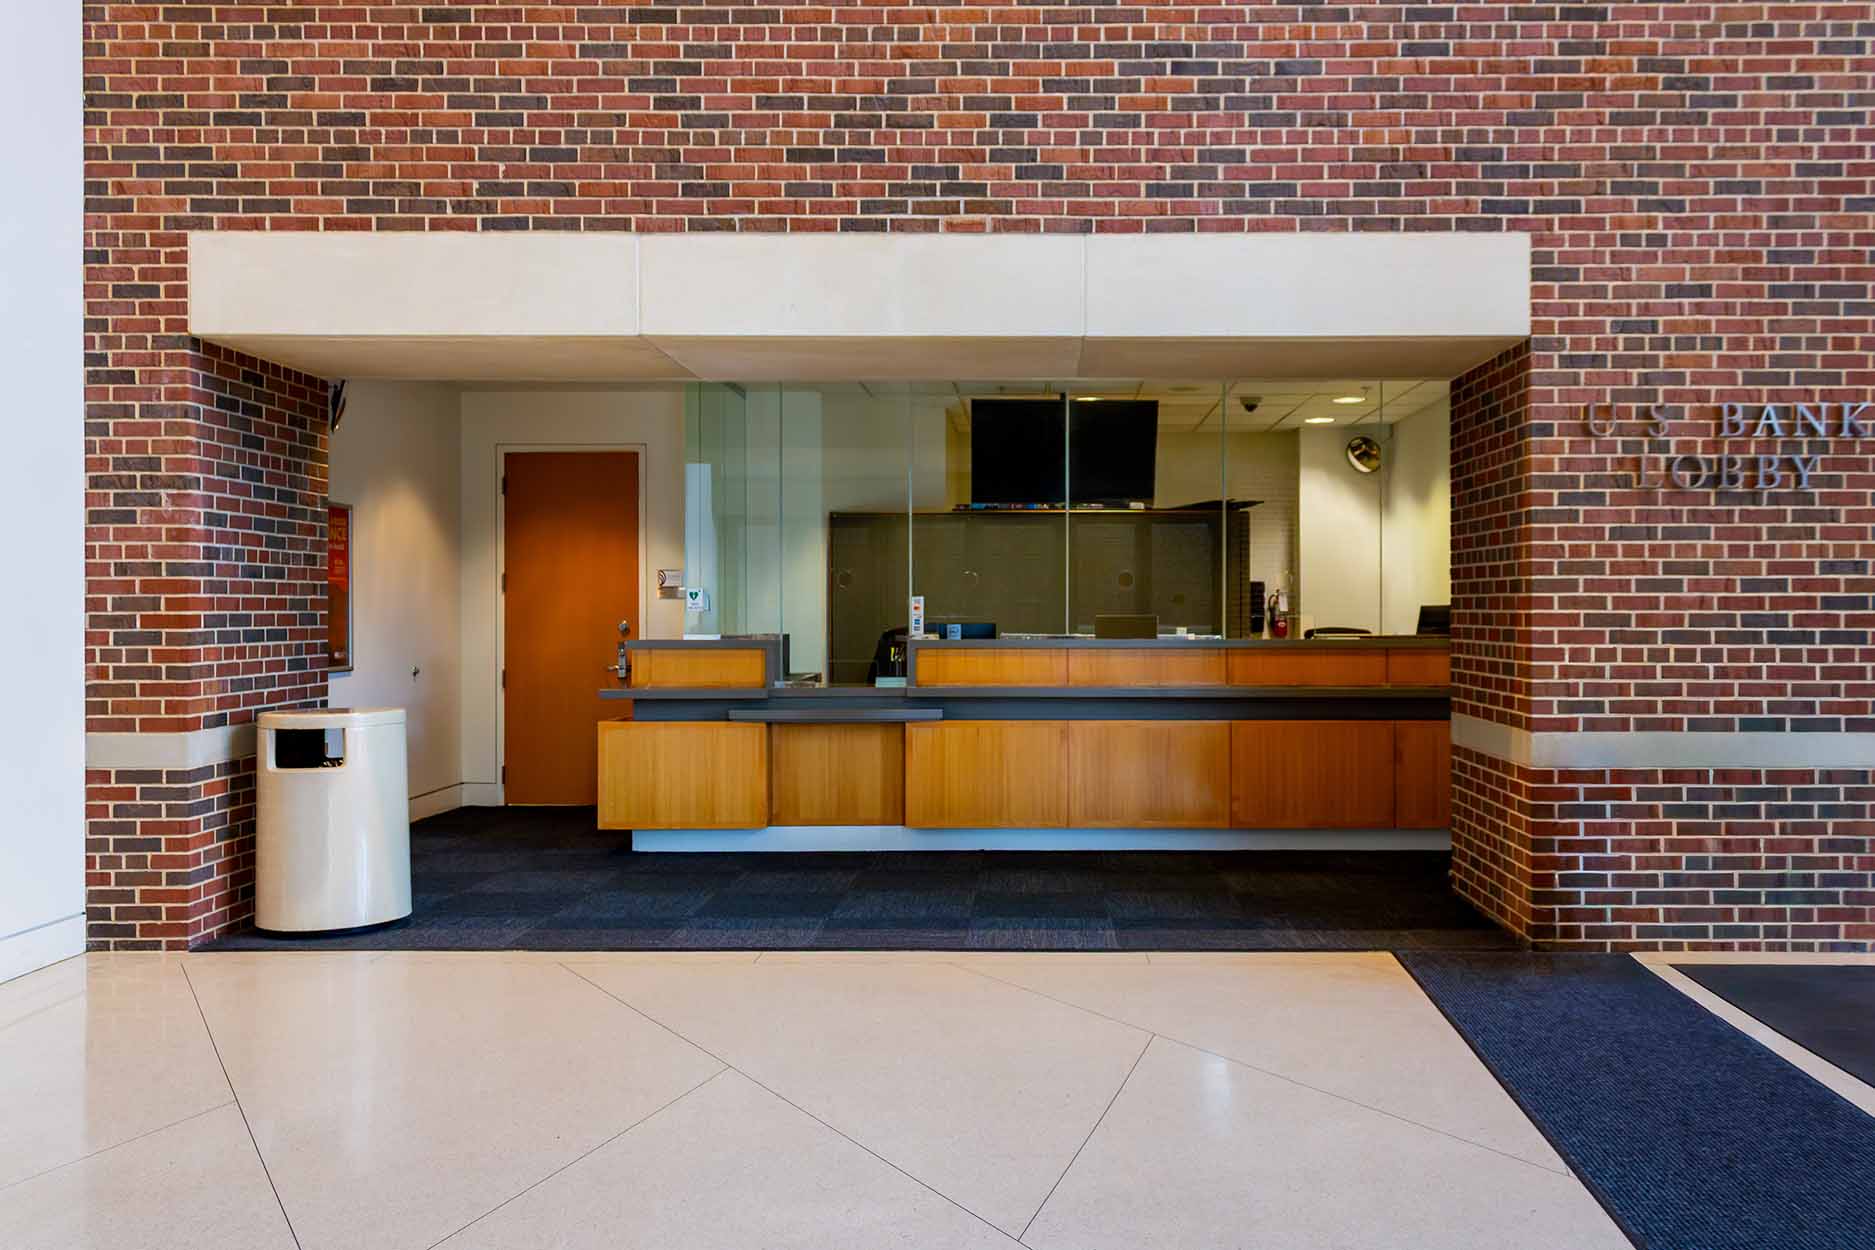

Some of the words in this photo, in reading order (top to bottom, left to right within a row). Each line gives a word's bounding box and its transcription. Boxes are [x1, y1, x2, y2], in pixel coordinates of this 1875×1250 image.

[1588, 402, 1617, 437] U
[1648, 403, 1670, 437] S
[1719, 402, 1873, 437] BANK
[1636, 455, 1819, 489] LOBBY
